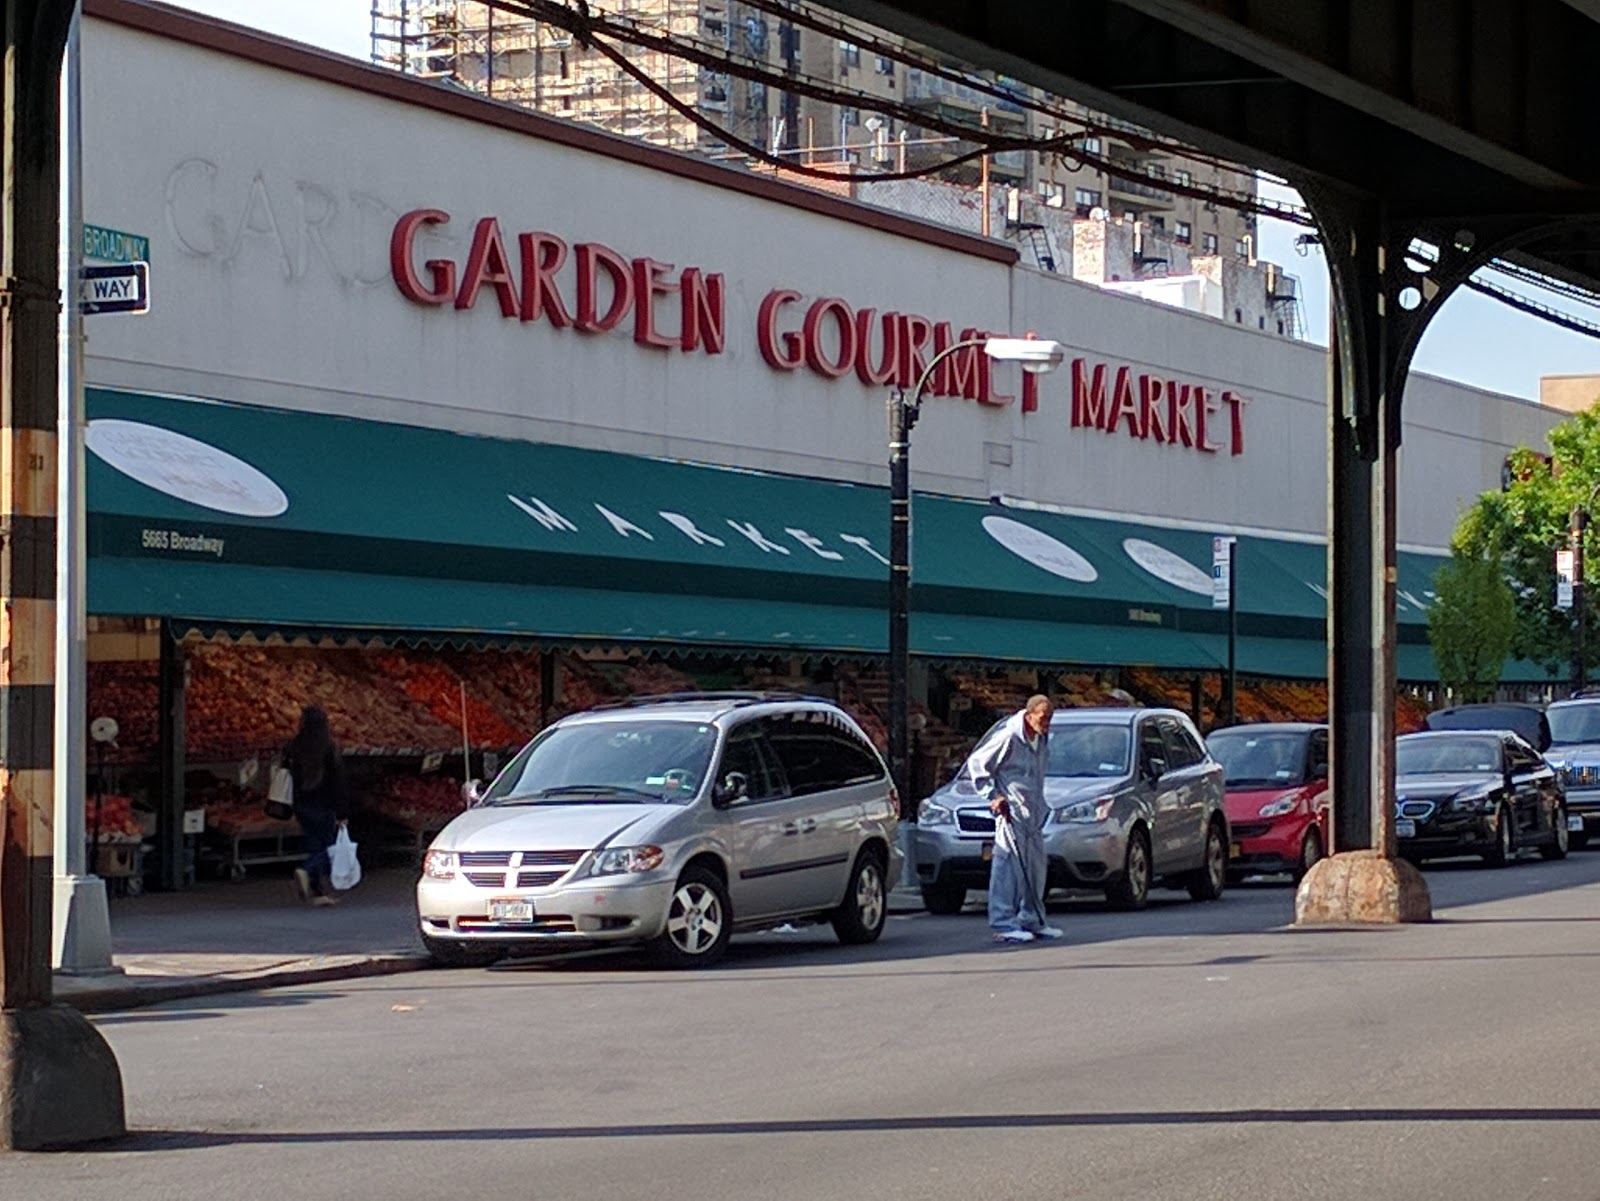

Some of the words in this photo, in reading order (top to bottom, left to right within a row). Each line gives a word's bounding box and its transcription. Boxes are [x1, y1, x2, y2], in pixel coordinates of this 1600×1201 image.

[84, 227, 146, 260] BROADWAY
[94, 279, 131, 298] WAY
[390, 208, 725, 354] GARDEN
[757, 289, 1040, 412] GOURMET
[1071, 358, 1249, 456] MARKET
[170, 531, 224, 556] Broadway
[507, 494, 890, 565] MARKET
